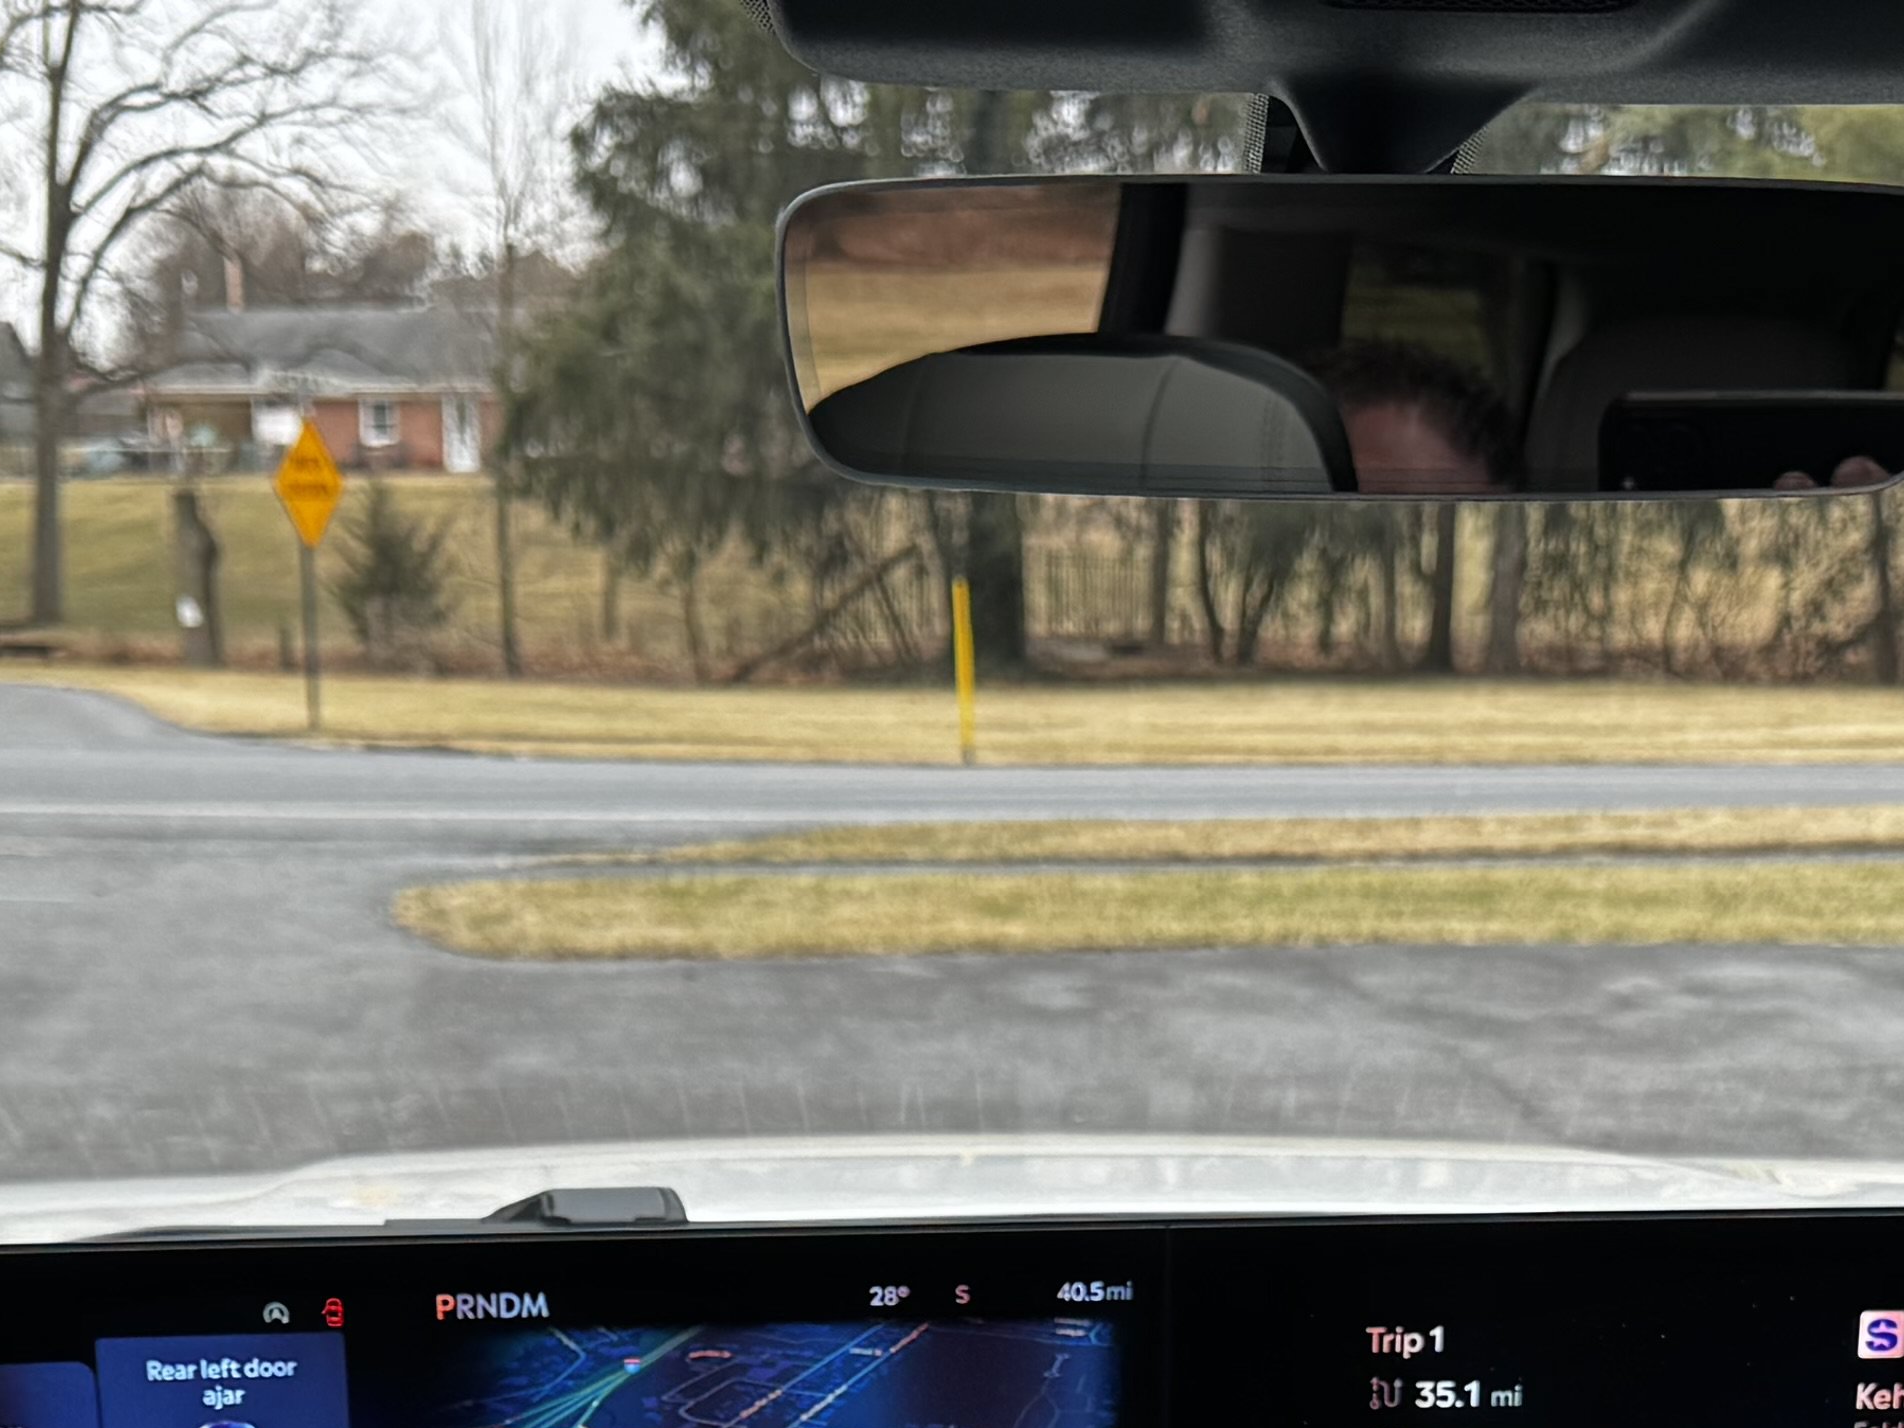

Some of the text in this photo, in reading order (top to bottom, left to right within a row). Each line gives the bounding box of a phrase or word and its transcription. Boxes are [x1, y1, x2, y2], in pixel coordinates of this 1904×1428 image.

[954, 1284, 970, 1305] S
[1056, 1280, 1134, 1302] 40.5 mi
[435, 1291, 550, 1320] PRNDM
[1366, 1325, 1445, 1359] Trip 1
[146, 1355, 297, 1382] Rear left door
[202, 1384, 246, 1410] ajar
[1415, 1380, 1523, 1409] 35.1 mi
